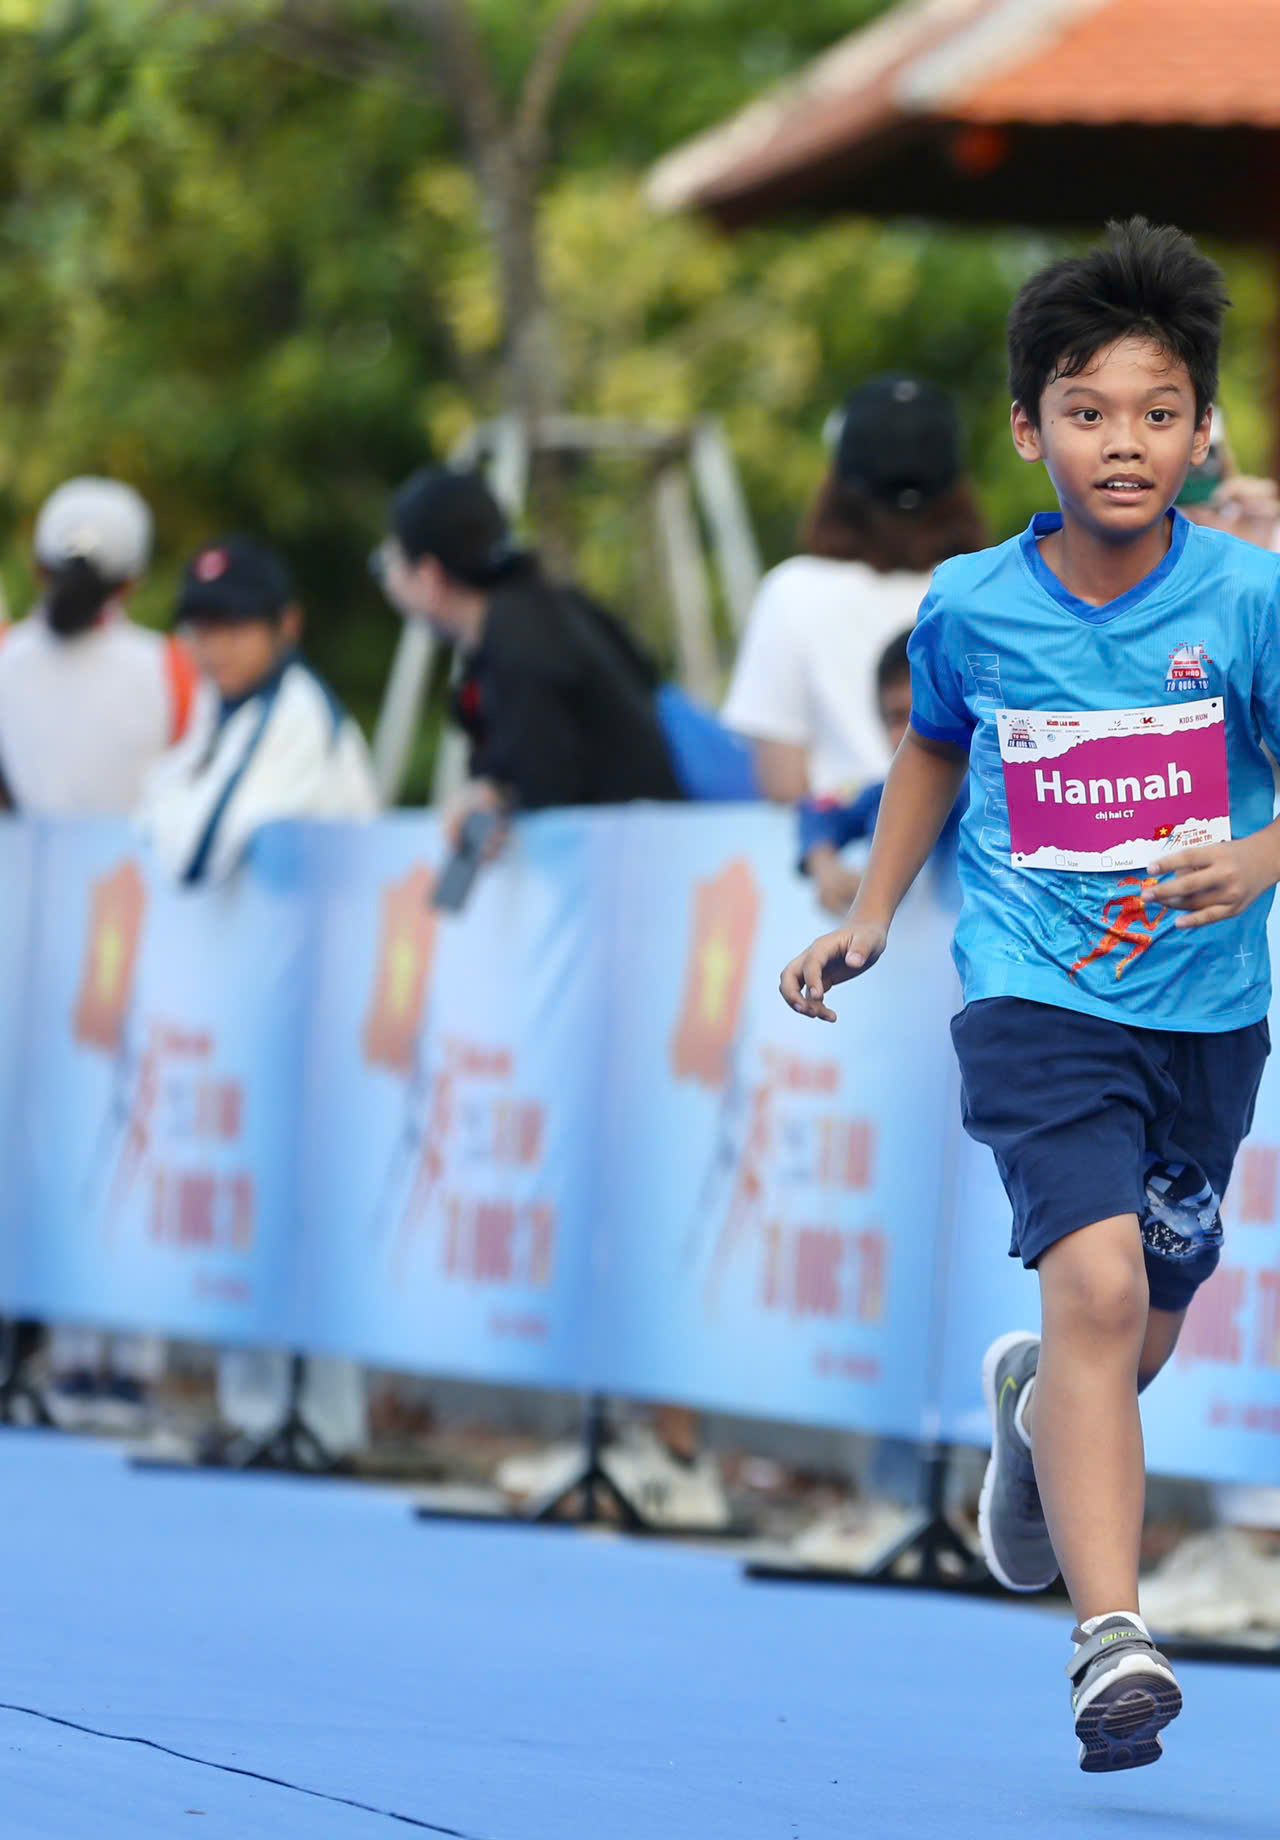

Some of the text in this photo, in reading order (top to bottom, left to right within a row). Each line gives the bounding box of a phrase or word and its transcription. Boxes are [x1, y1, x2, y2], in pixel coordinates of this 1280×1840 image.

[1179, 713, 1208, 725] KIDS RUN
[1034, 761, 1193, 805] Hannah
[1109, 810, 1122, 819] hai
[1123, 809, 1134, 818] CT
